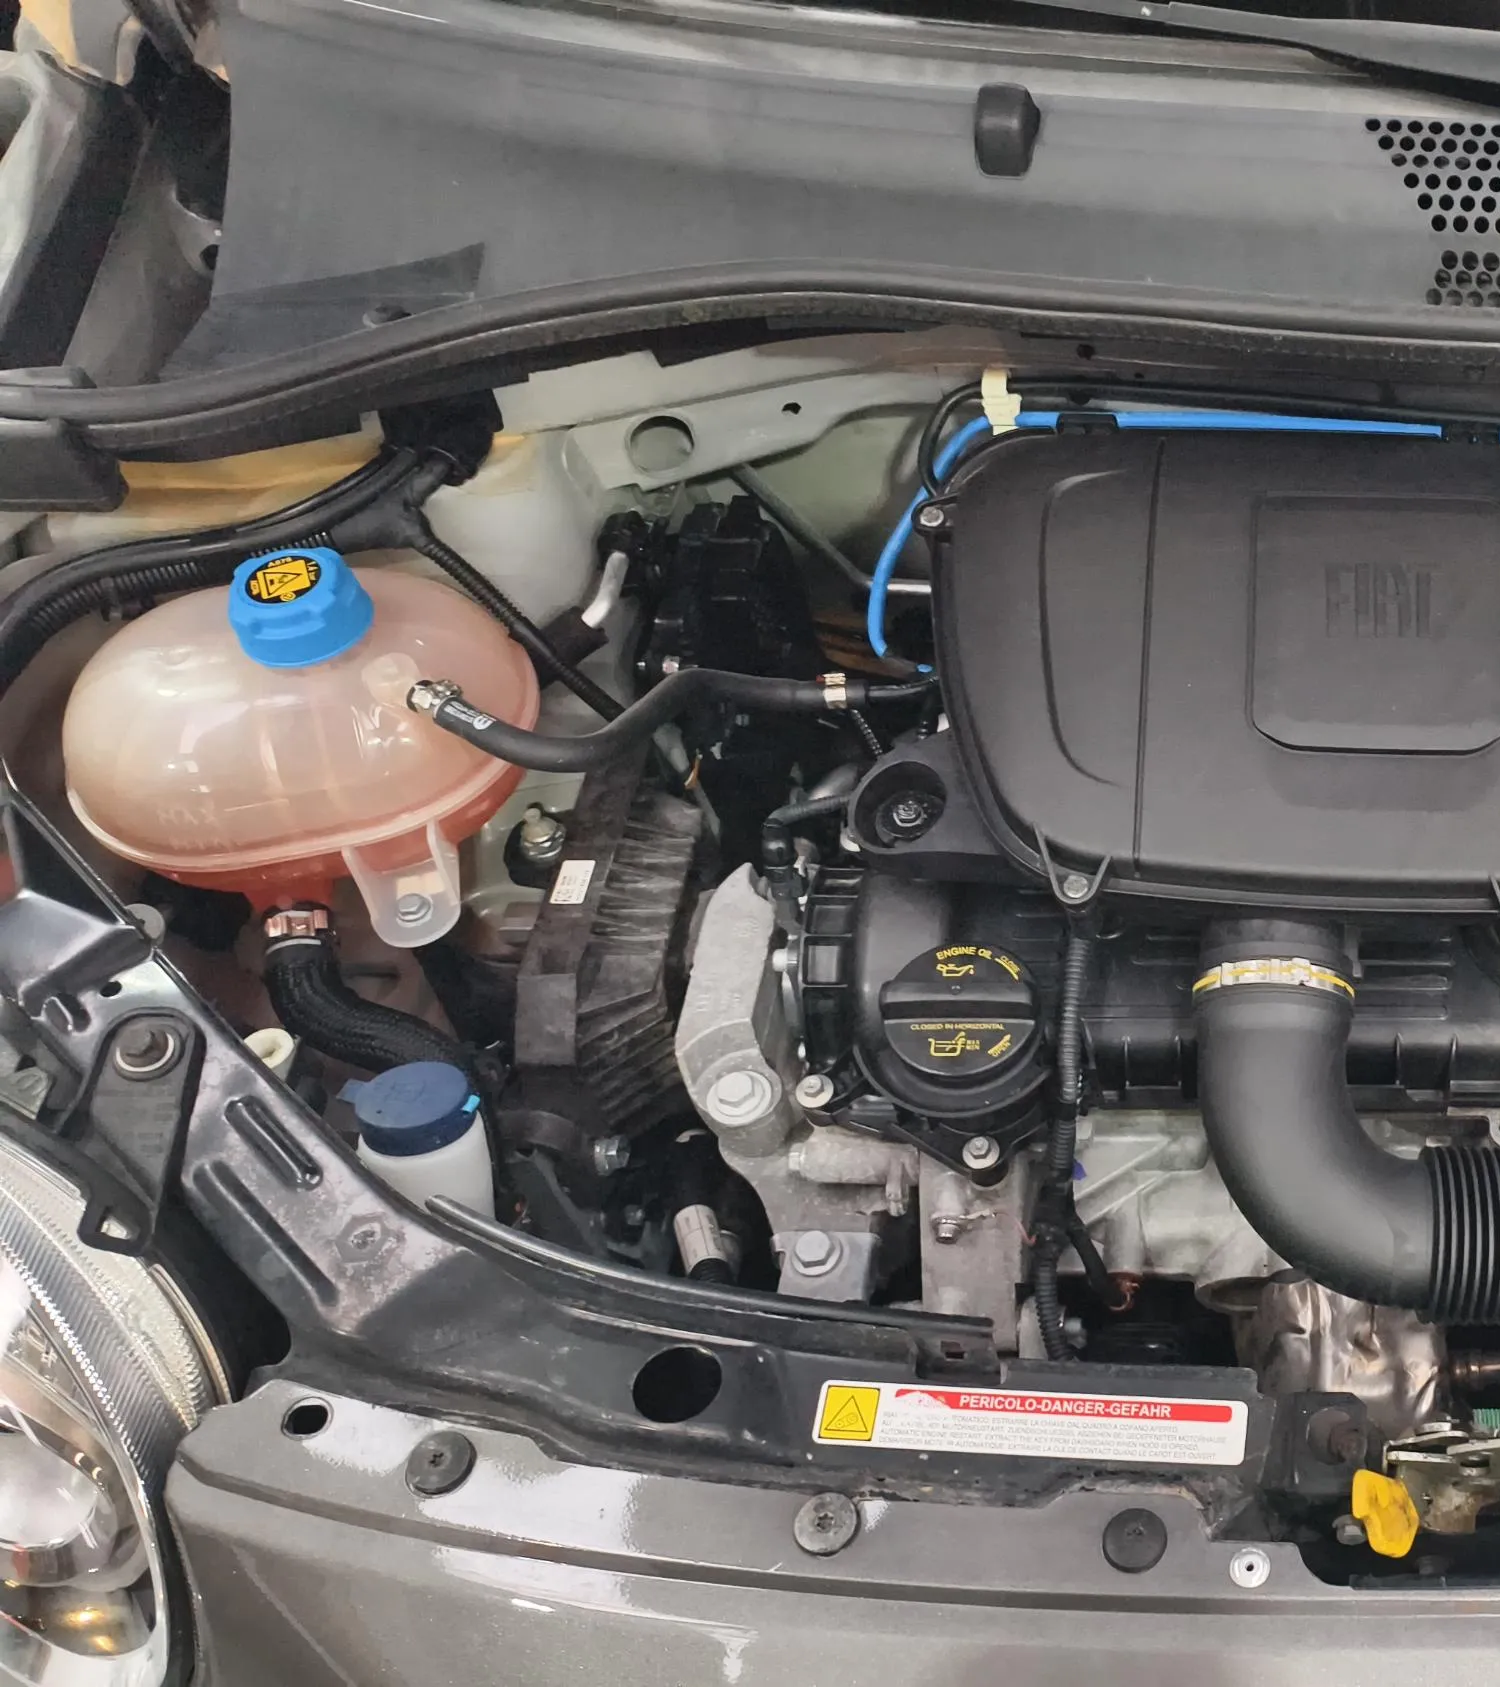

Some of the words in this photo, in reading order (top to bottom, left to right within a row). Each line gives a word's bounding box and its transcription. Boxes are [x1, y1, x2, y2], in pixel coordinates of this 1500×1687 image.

[1324, 562, 1441, 638] FIAT
[936, 946, 976, 960] ENGINE
[978, 948, 993, 959] OIL
[959, 1394, 1171, 1418] PERICOLO-DANGER-GEFAHR
